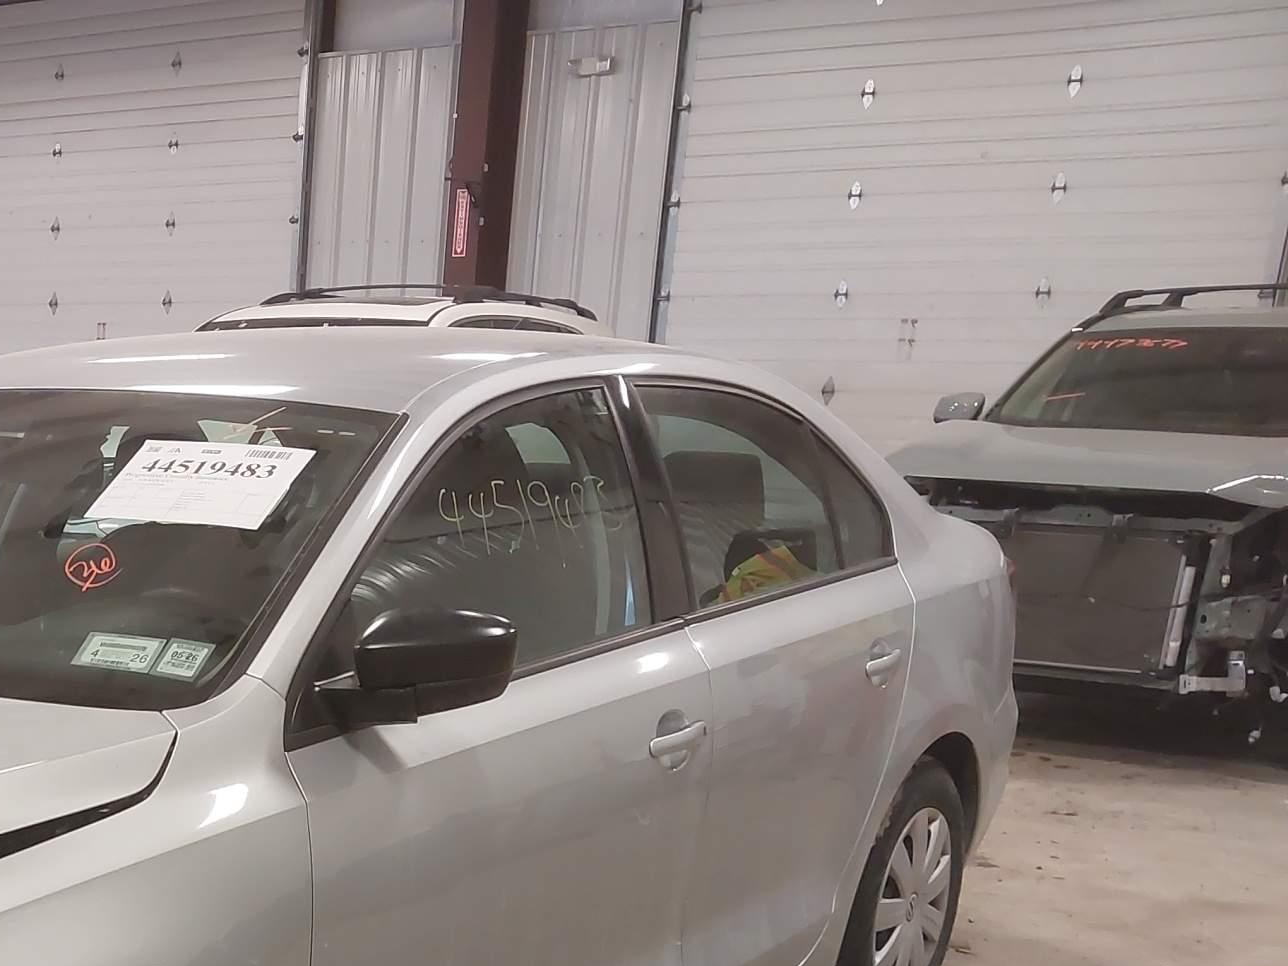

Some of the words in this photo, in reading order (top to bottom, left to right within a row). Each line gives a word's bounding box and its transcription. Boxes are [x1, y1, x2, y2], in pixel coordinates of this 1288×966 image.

[141, 458, 278, 479] 44519483
[90, 649, 100, 657] 4
[129, 653, 149, 664] 26
